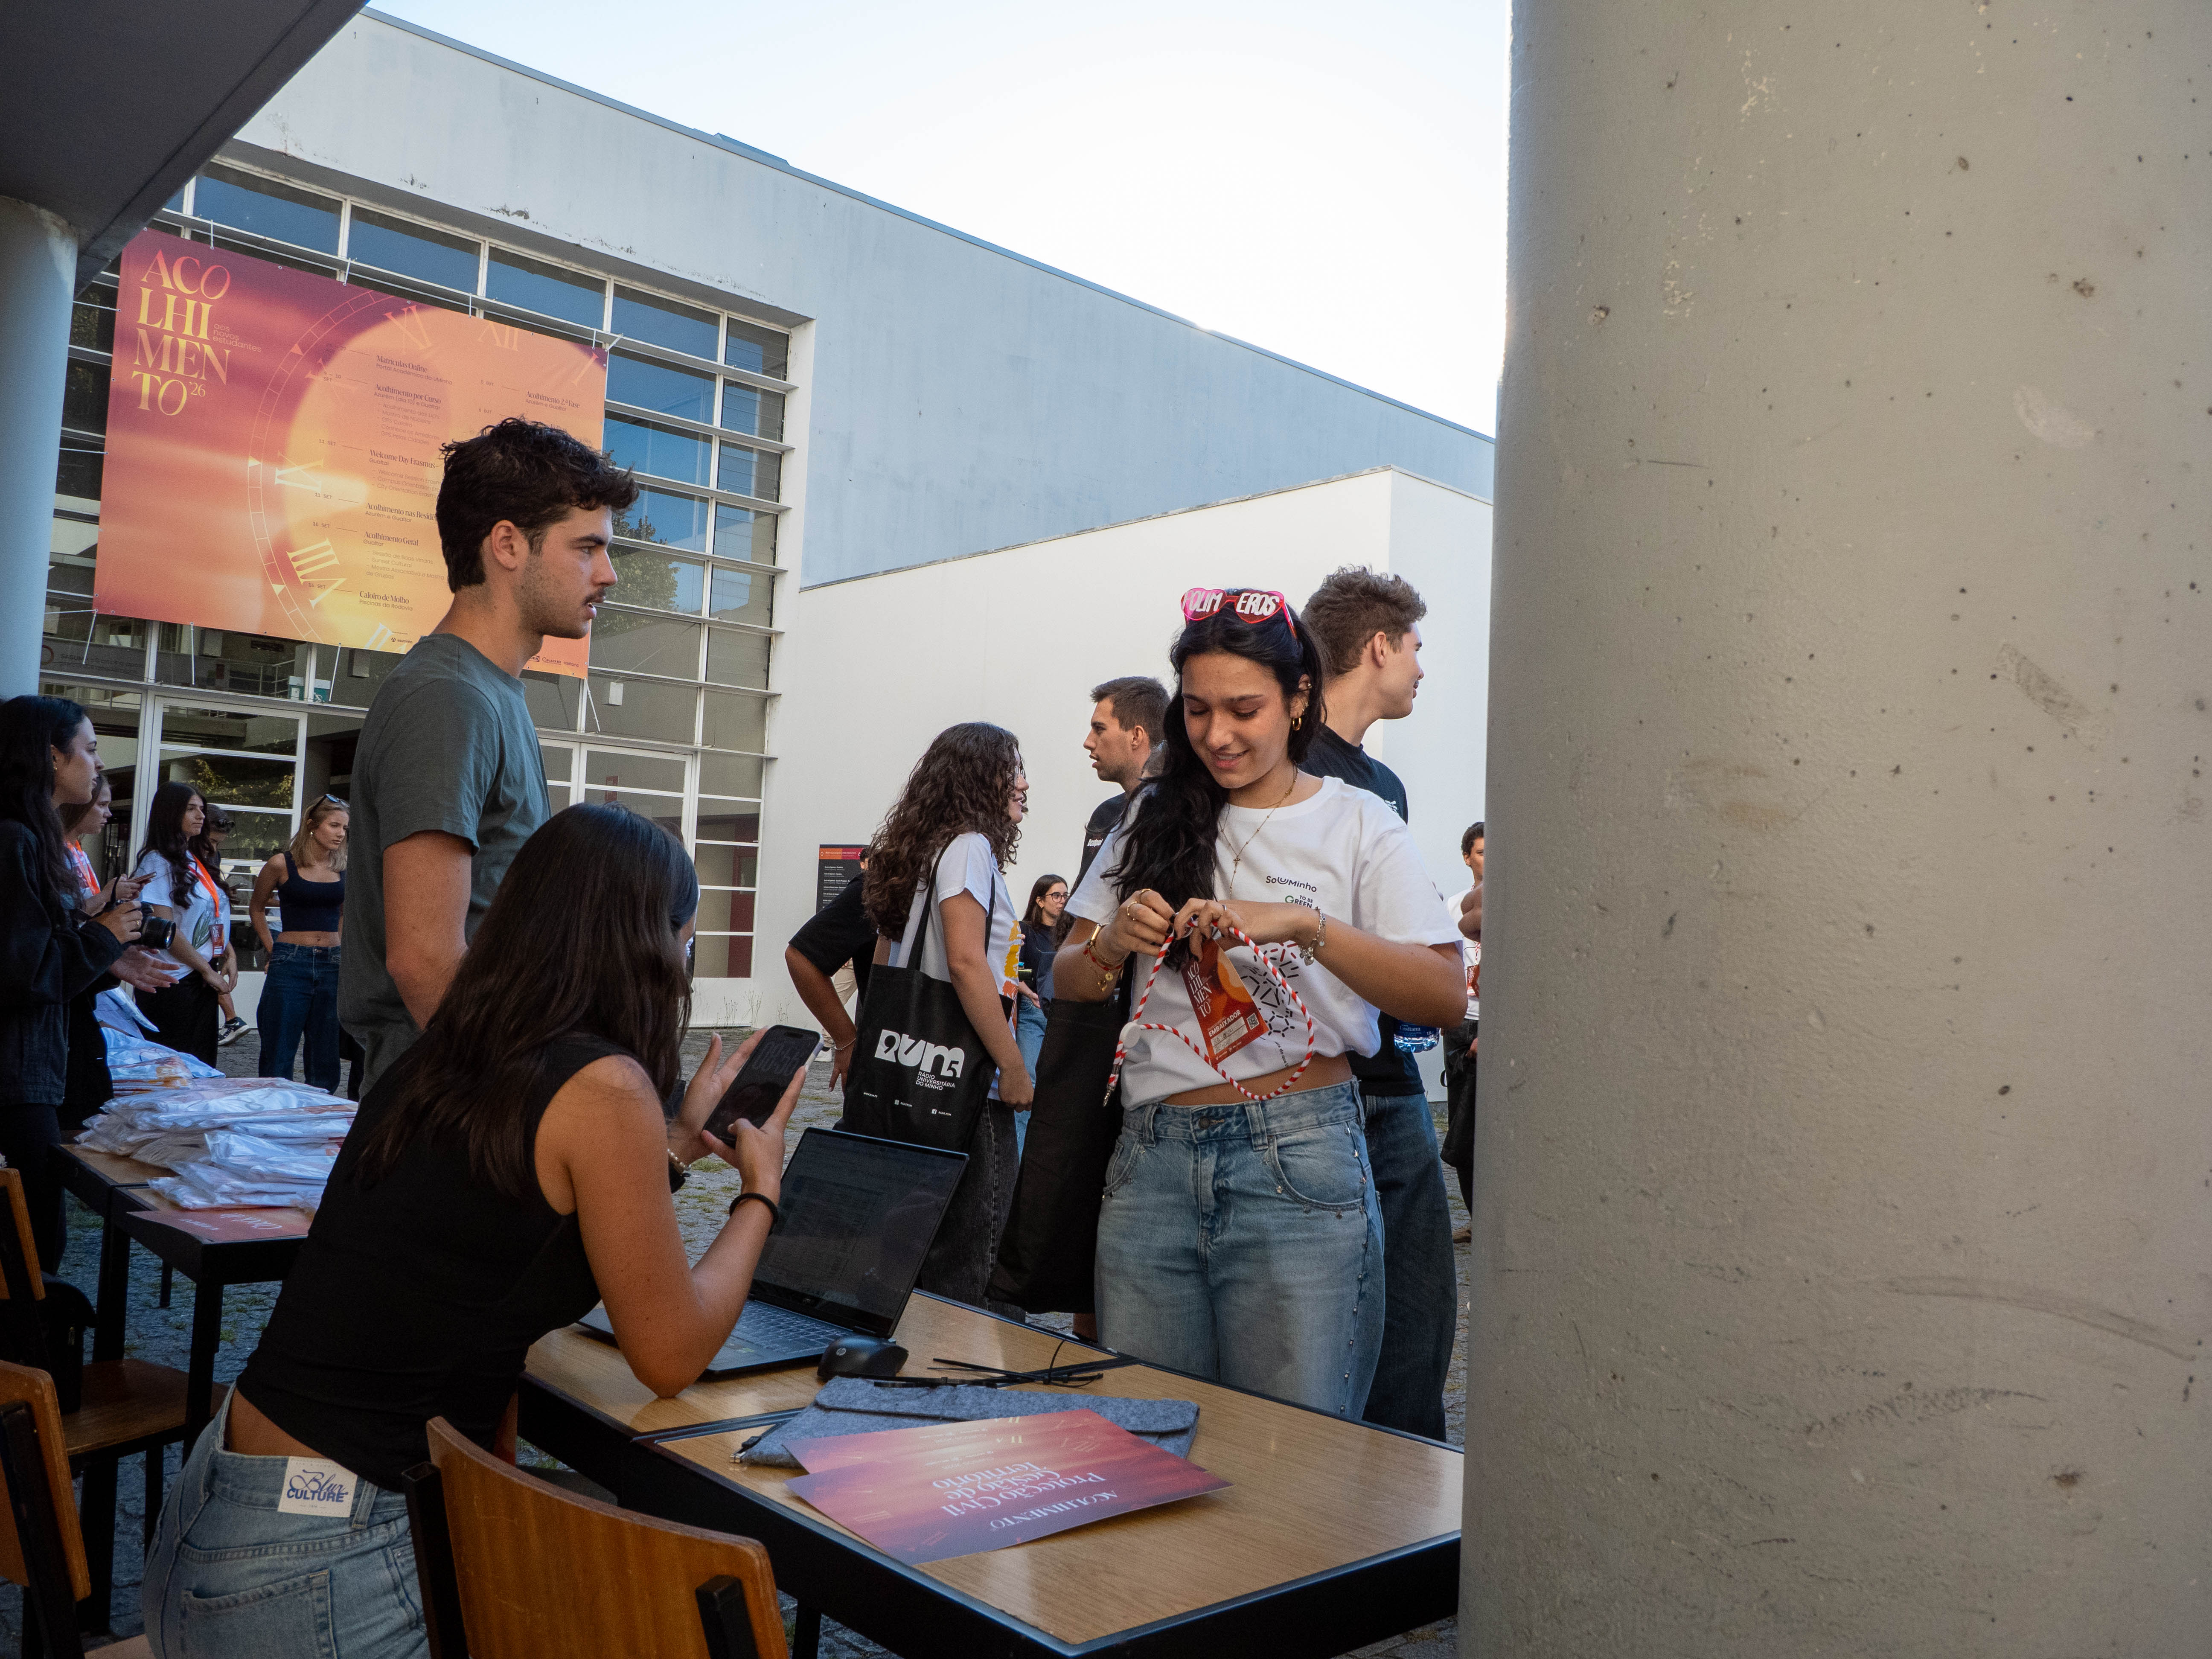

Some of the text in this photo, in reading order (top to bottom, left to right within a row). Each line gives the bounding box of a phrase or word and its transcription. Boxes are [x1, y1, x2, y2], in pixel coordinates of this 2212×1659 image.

[141, 250, 230, 300] ACO
[137, 287, 213, 341] LHI
[214, 323, 230, 331] aos
[213, 329, 239, 341] novos
[212, 336, 262, 352] estudantes
[133, 328, 231, 385] MEN
[376, 363, 392, 371] Portal
[433, 376, 452, 385] UMinho
[408, 362, 428, 373] Online
[131, 370, 187, 416] TO
[375, 384, 441, 404] Acolhimento por Curso
[526, 391, 559, 405] Acolhimento
[568, 400, 580, 409] Fase
[421, 402, 441, 410] Gualtar
[549, 403, 567, 412] Gualtar
[369, 458, 389, 466] Gualtar
[370, 449, 398, 461] Welcome
[398, 455, 409, 465] Day
[378, 469, 404, 478] Welcome
[388, 485, 418, 495] Orientation
[419, 491, 437, 499] Erasm
[402, 481, 431, 491] Orientation
[367, 503, 404, 515] Acolhimento
[392, 515, 412, 523] Gualtar
[363, 539, 384, 547] Gualtar
[364, 531, 419, 546] Acolhimento Geral
[391, 560, 412, 568] Cultural
[391, 568, 421, 577] Associativa
[359, 591, 381, 600] Caloiro
[390, 594, 410, 605] Molho
[1236, 593, 1280, 616] EROS
[359, 599, 381, 607] Piscinas
[391, 603, 413, 612] Rodovia
[1285, 895, 1313, 908] GREEN
[1187, 961, 1200, 979] ACO
[1190, 975, 1204, 991] LHI
[1193, 984, 1212, 1005] MEN
[1198, 1001, 1211, 1018] TO
[1209, 1010, 1241, 1037] EMBAIXADOR
[917, 1076, 955, 1089] UNIVERSITÁRIA
[918, 1071, 935, 1080] RÁDIO
[924, 1082, 943, 1091] MINHO
[932, 1462, 1046, 1490] Território
[943, 1470, 1061, 1501] Gestão de
[287, 1489, 344, 1502] CULTURE
[940, 1471, 1106, 1517] Proteção Civil
[990, 1490, 1118, 1530] ACOLHIMENTO
